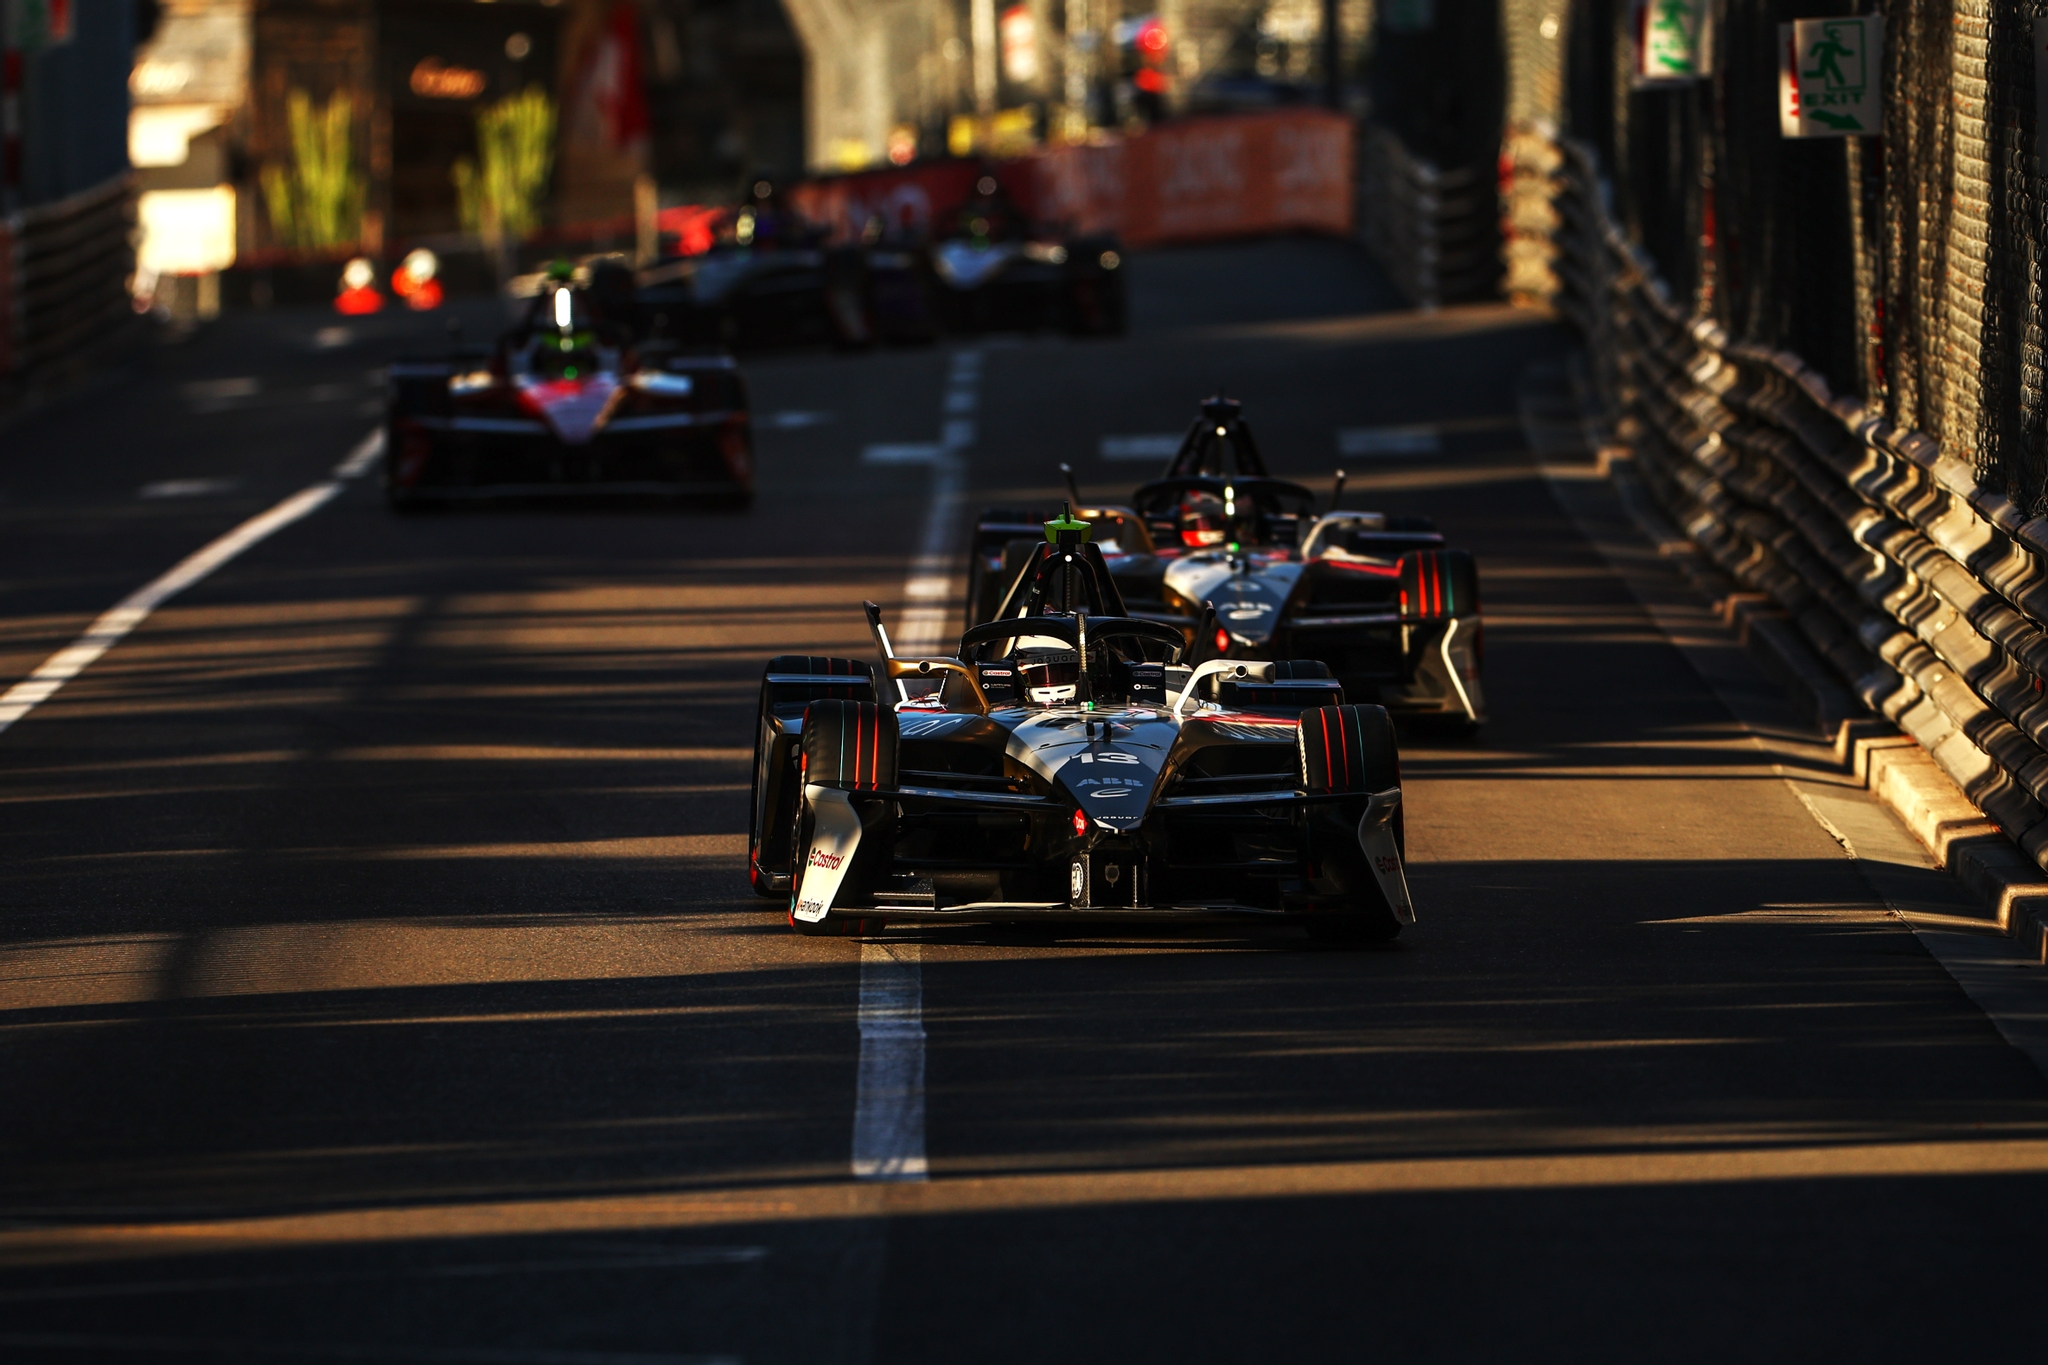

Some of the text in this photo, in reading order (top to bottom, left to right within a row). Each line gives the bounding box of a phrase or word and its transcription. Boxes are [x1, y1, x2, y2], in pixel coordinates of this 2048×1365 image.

[1804, 91, 1865, 107] EXIT
[1071, 752, 1140, 765] 13
[1076, 777, 1143, 788] ABB
[812, 849, 845, 871] Castrol
